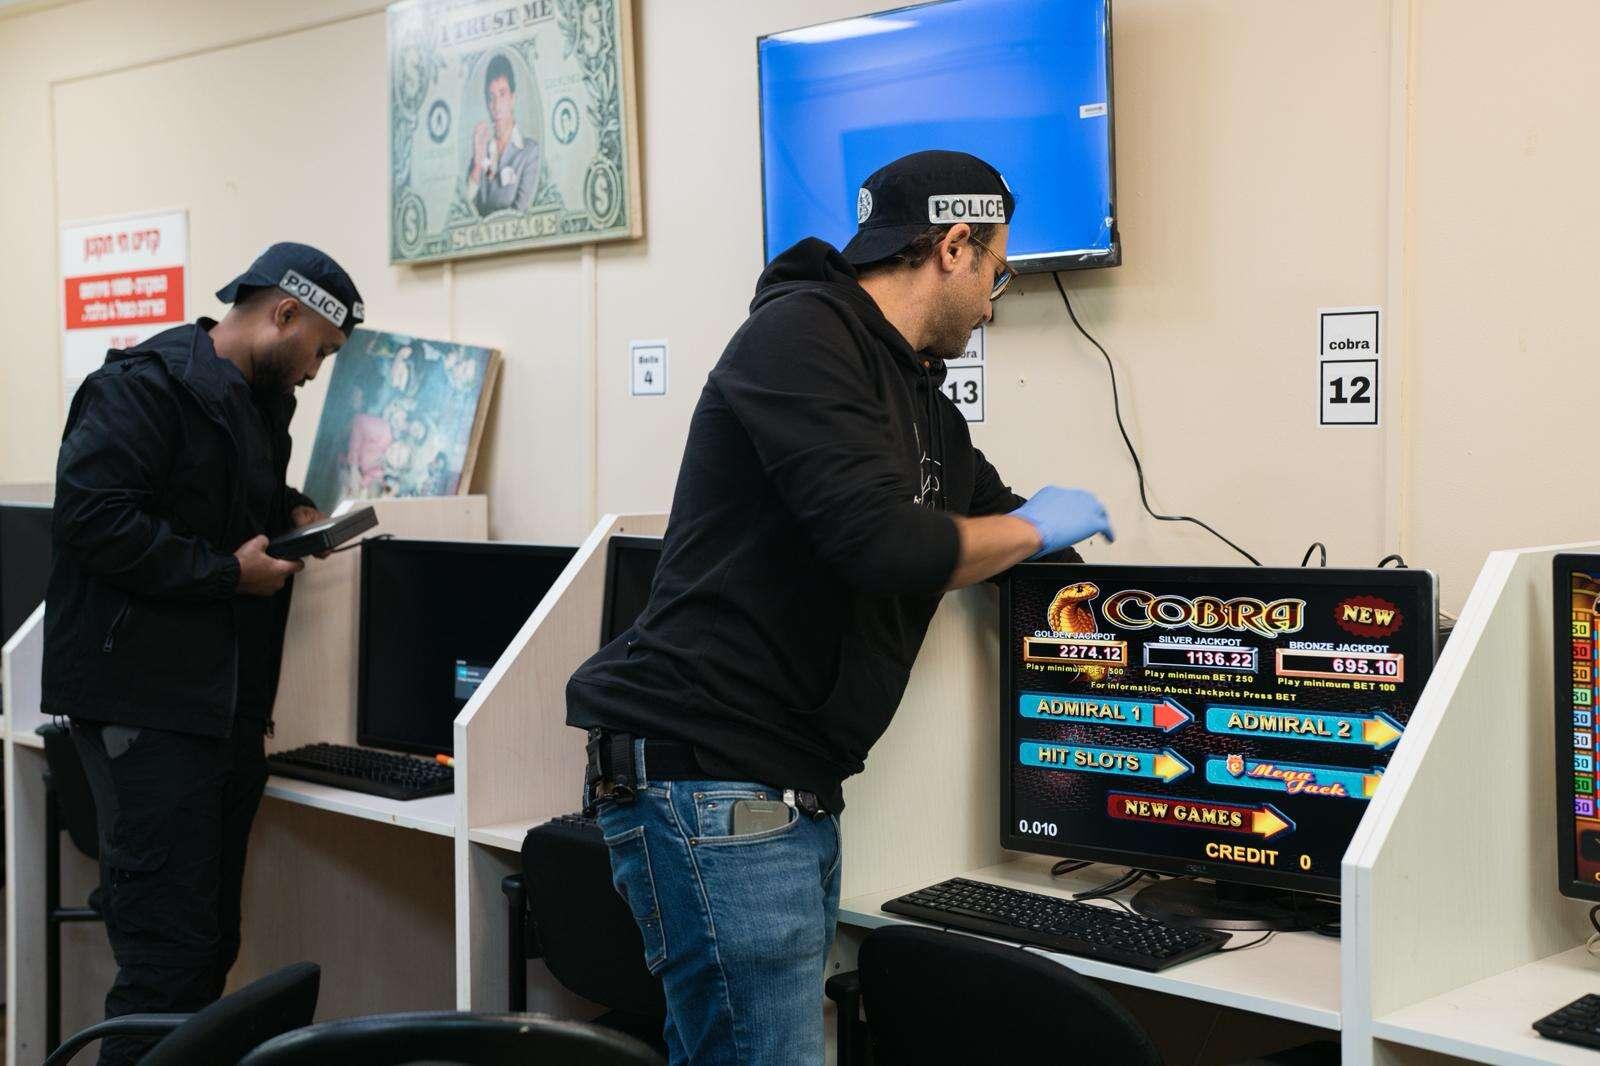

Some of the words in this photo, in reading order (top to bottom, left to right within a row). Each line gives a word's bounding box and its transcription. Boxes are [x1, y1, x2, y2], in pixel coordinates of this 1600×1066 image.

[935, 199, 1004, 218] POLICE
[285, 274, 344, 322] POLICE
[1329, 338, 1370, 350] cobra
[645, 370, 653, 386] 4
[948, 380, 978, 404] 13
[1329, 376, 1371, 403] 12
[1102, 589, 1306, 638] COBRA
[1342, 604, 1396, 627] NEW
[1034, 630, 1071, 639] GOLDEN
[1073, 632, 1116, 641] JACKPOT
[1158, 635, 1193, 644] SILVER
[1194, 638, 1242, 647] JACKPOT
[1060, 645, 1121, 660] 2274.12
[1289, 641, 1334, 651] BRONZE
[1336, 644, 1389, 654] JACKPOT
[1026, 663, 1045, 671] Play
[1047, 664, 1085, 673] minimum
[1086, 666, 1105, 674] BET
[1186, 651, 1252, 667] 1136.22
[1332, 658, 1397, 675] 695.10
[1144, 669, 1165, 679] Play
[1168, 671, 1210, 680] minimum
[1213, 673, 1233, 682] BET
[1235, 675, 1254, 683] 250
[1278, 677, 1300, 687] Play
[1303, 679, 1350, 689] minimum
[1353, 681, 1376, 690] BET
[1379, 683, 1396, 691] 100
[1091, 681, 1105, 689] For
[1164, 685, 1193, 695] About
[1195, 688, 1240, 698] Jackpots
[1243, 690, 1273, 699] Press
[1276, 693, 1297, 701] BET
[1037, 698, 1126, 720] ADMIRAL
[1132, 706, 1142, 721] 1
[1228, 712, 1332, 737] ADMIRAL
[1337, 720, 1352, 738] 2
[1038, 747, 1068, 765] HIT
[1075, 750, 1140, 771] SLOTS
[1247, 764, 1313, 780] Mega
[1286, 779, 1347, 796] Jack
[1125, 799, 1168, 818] NEW
[1174, 804, 1243, 827] GAMES
[1019, 818, 1058, 837] 0.010
[1206, 842, 1279, 867] CREDIT
[1300, 854, 1311, 870] 0
